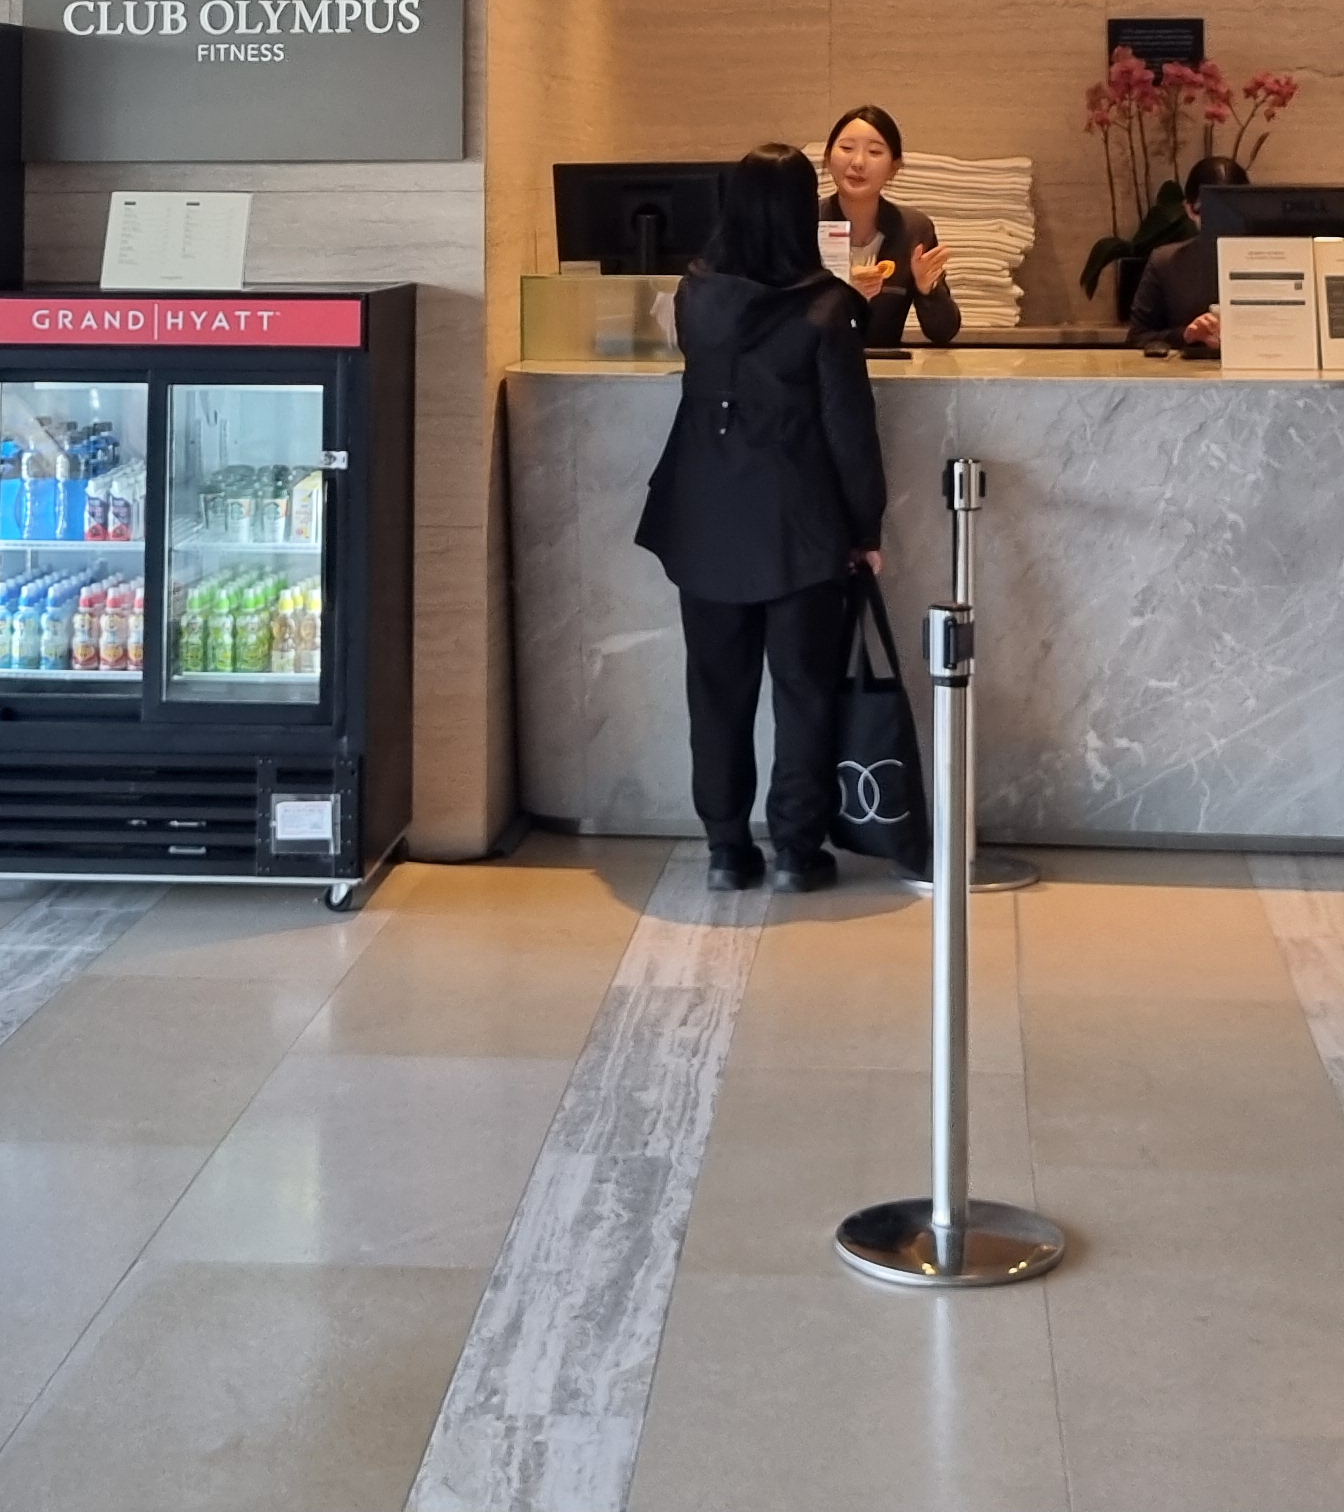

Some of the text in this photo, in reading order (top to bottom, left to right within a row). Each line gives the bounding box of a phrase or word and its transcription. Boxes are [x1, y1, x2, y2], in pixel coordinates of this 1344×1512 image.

[197, 43, 285, 62] FITNESS
[31, 309, 275, 331] GRAND HYATT
